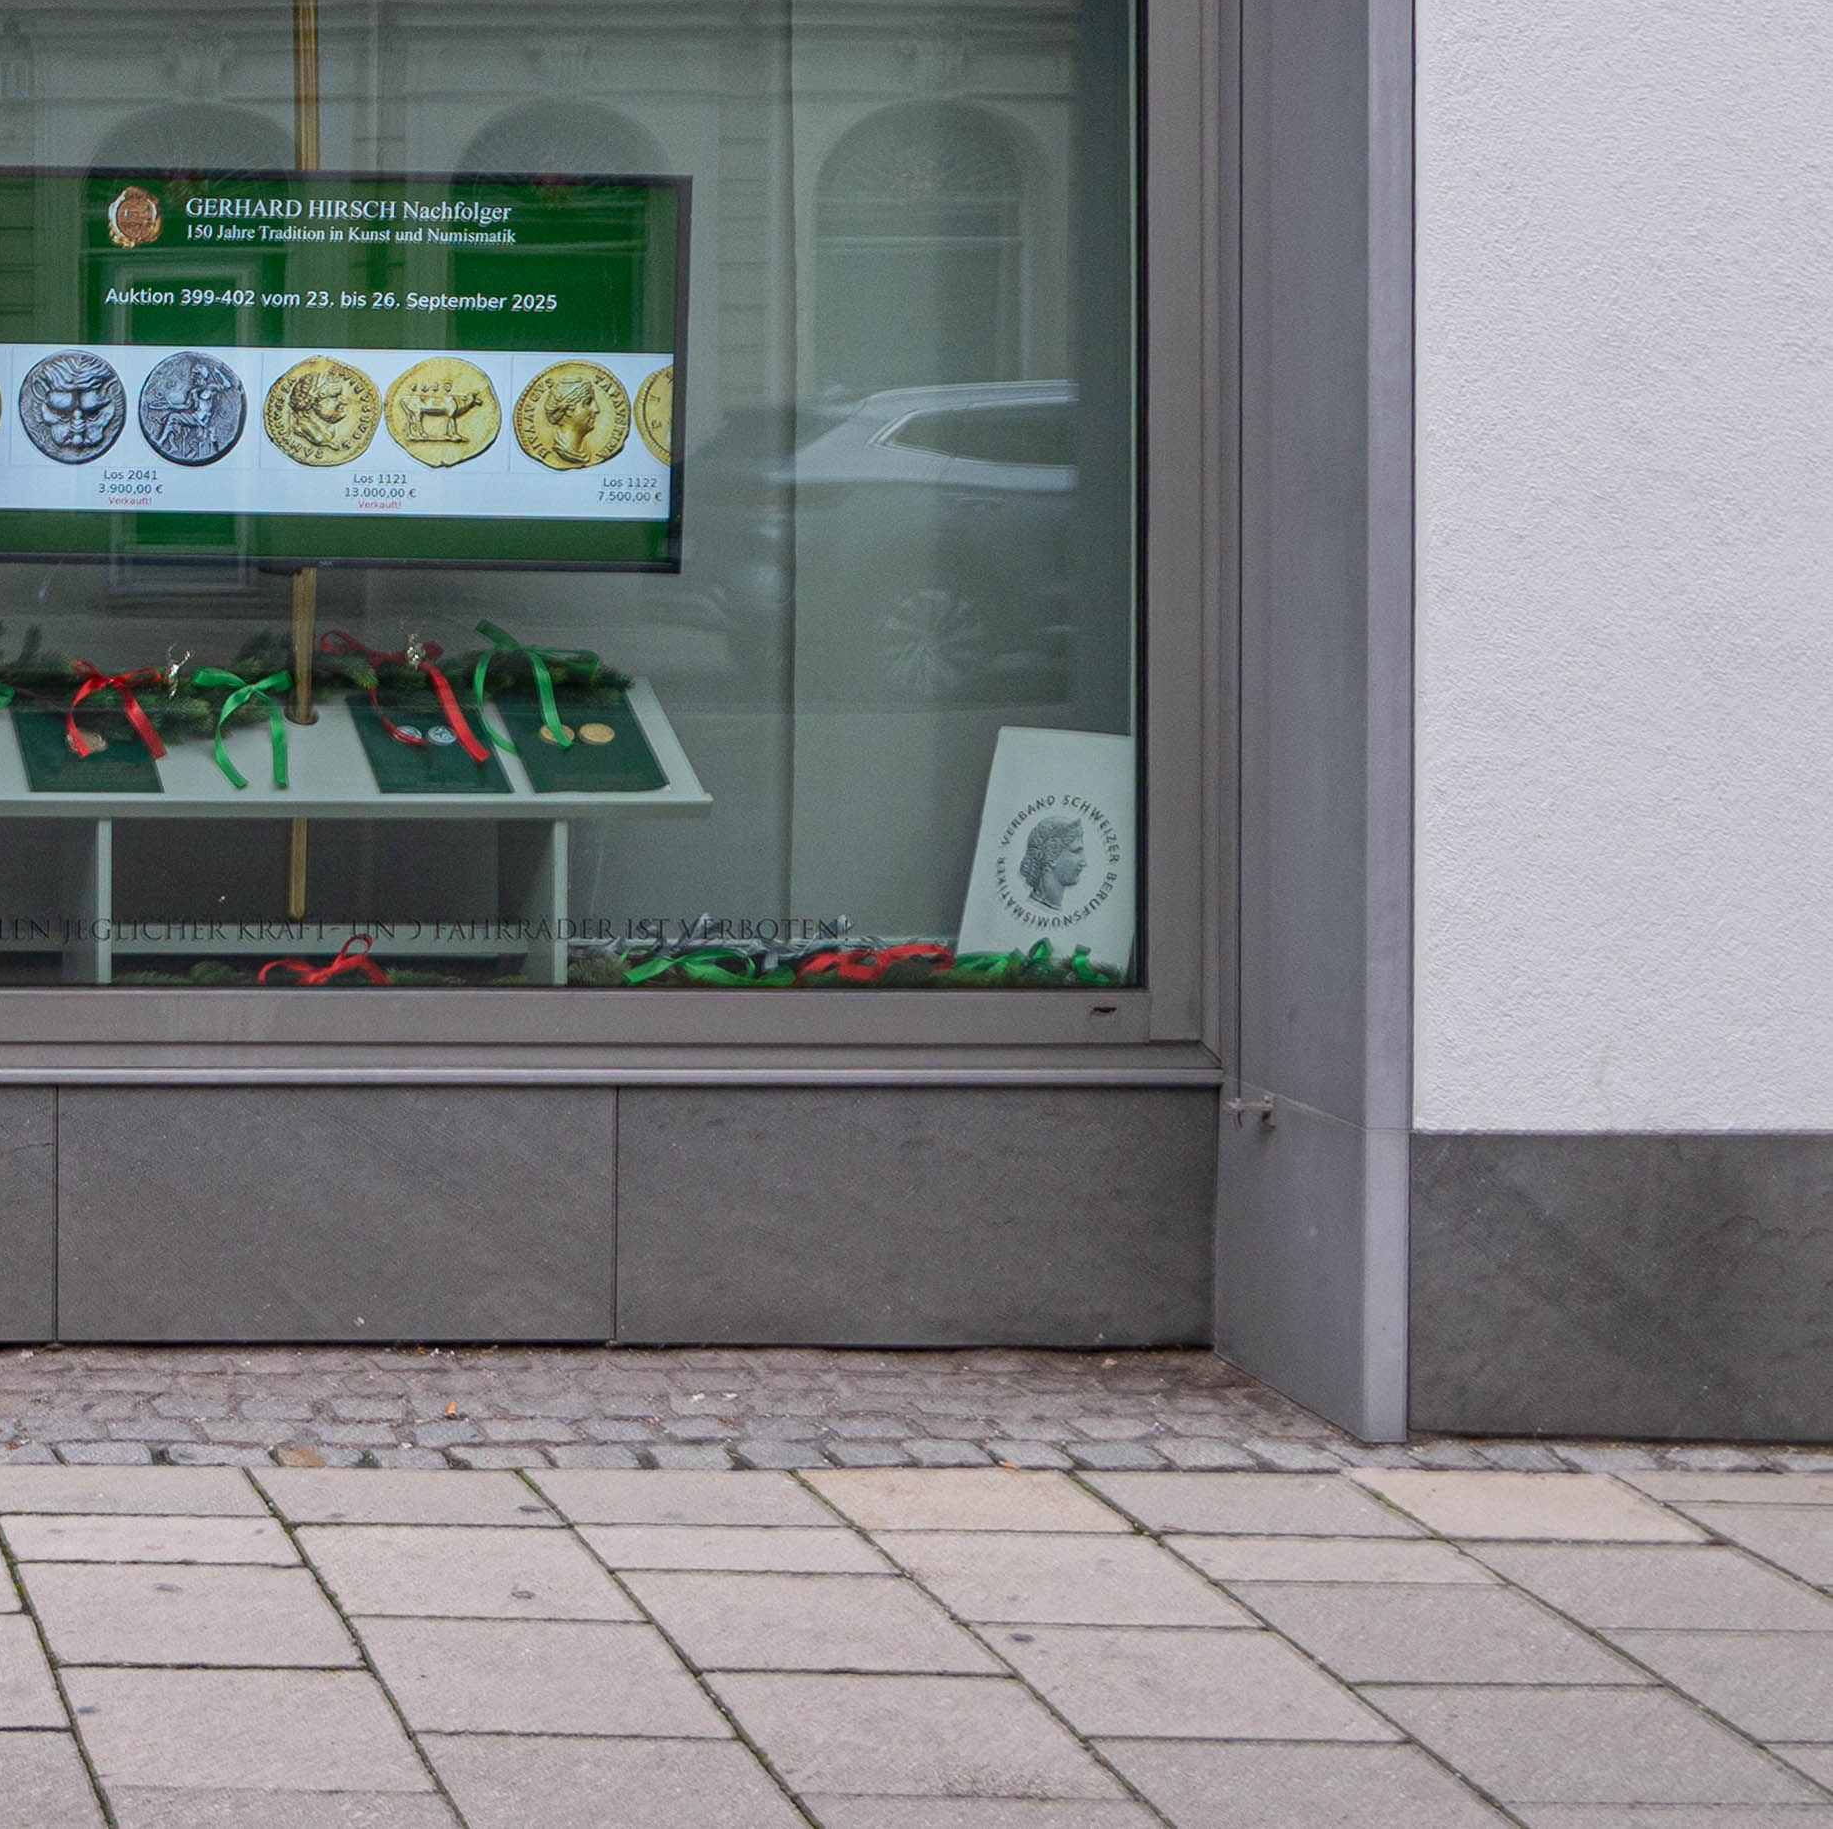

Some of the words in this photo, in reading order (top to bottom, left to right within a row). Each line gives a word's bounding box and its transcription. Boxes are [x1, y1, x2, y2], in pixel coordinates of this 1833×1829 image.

[185, 197, 303, 220] GERHARD
[309, 199, 396, 220] HIRSCH
[402, 200, 512, 226] Nachfolger
[186, 225, 213, 239] 150
[216, 225, 256, 240] Jahre
[258, 225, 326, 242] Tradition
[329, 226, 344, 241] in
[348, 227, 391, 242] Kunst
[395, 228, 423, 243] und
[427, 228, 516, 244] Numismatik
[104, 288, 175, 306] Auktion
[179, 289, 255, 307] 399-402
[261, 294, 301, 307] vom
[305, 291, 334, 308] 23.
[339, 291, 367, 309] bis
[371, 291, 401, 309] 26.
[405, 292, 508, 315] September
[511, 294, 558, 312] 2025
[104, 470, 124, 480] Los
[128, 470, 158, 481] 2041
[353, 474, 374, 484] Los
[379, 474, 408, 485] 1121
[98, 483, 153, 496] 3.900,00
[156, 483, 164, 495] €
[603, 477, 623, 488] Los
[628, 478, 658, 489] 1122
[345, 487, 406, 499] 13.000,00
[409, 488, 417, 499] €
[598, 491, 651, 503] 7.500,00
[654, 491, 662, 502] €
[108, 497, 153, 506] Verkauft!
[358, 500, 402, 510] Verkauft!
[1000, 794, 1057, 847] VERBAND
[1062, 794, 1121, 864] SCHWEIZER
[996, 855, 1119, 928] BERUFSNUMISMATIKER
[62, 918, 227, 944] JEGLICHER
[434, 915, 618, 941] FAHRRÄDER
[625, 918, 670, 940] IST
[678, 917, 851, 941] VERBOTEN!
